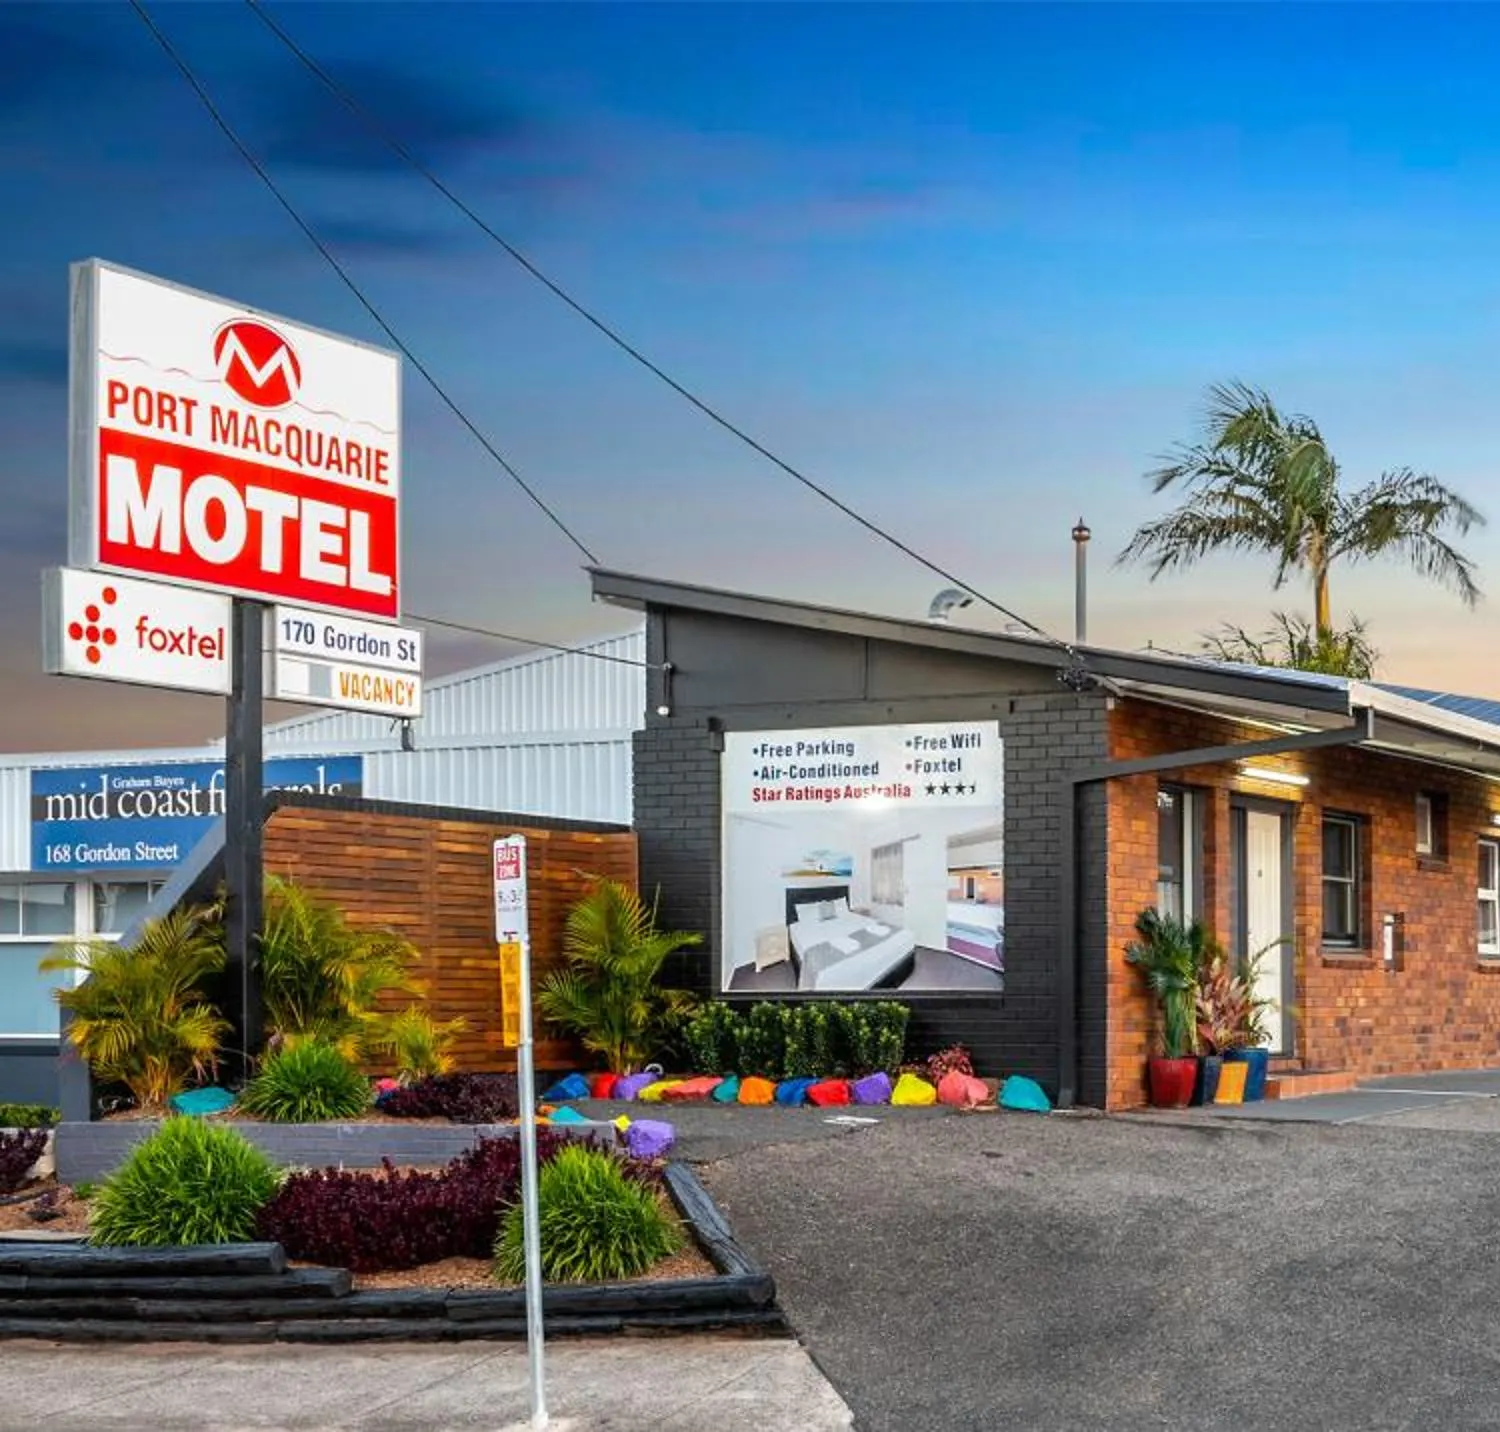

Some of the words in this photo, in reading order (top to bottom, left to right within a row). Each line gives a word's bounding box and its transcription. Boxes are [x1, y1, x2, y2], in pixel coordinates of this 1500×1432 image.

[216, 328, 299, 402] M
[107, 379, 197, 437] PORT
[210, 405, 389, 487] MACQUARIE
[106, 453, 396, 597] MOTEL
[136, 615, 225, 661] foxtel
[281, 618, 315, 646] 170
[323, 626, 391, 658] Gordon
[397, 639, 416, 663] St
[338, 670, 415, 708] VACANCY
[761, 743, 792, 758] Free
[796, 740, 855, 757] Parking
[914, 735, 947, 750] Free
[951, 732, 982, 749] Wifi
[761, 760, 880, 781] Air-Conditioned
[914, 757, 962, 773] Foxtel
[112, 776, 152, 789] Graham
[752, 787, 781, 802] Star
[785, 785, 841, 803] Ratings
[45, 774, 110, 822] mid
[117, 781, 202, 818] coast
[46, 845, 71, 864] 168
[75, 842, 131, 862] Gordon
[135, 841, 179, 861] Street
